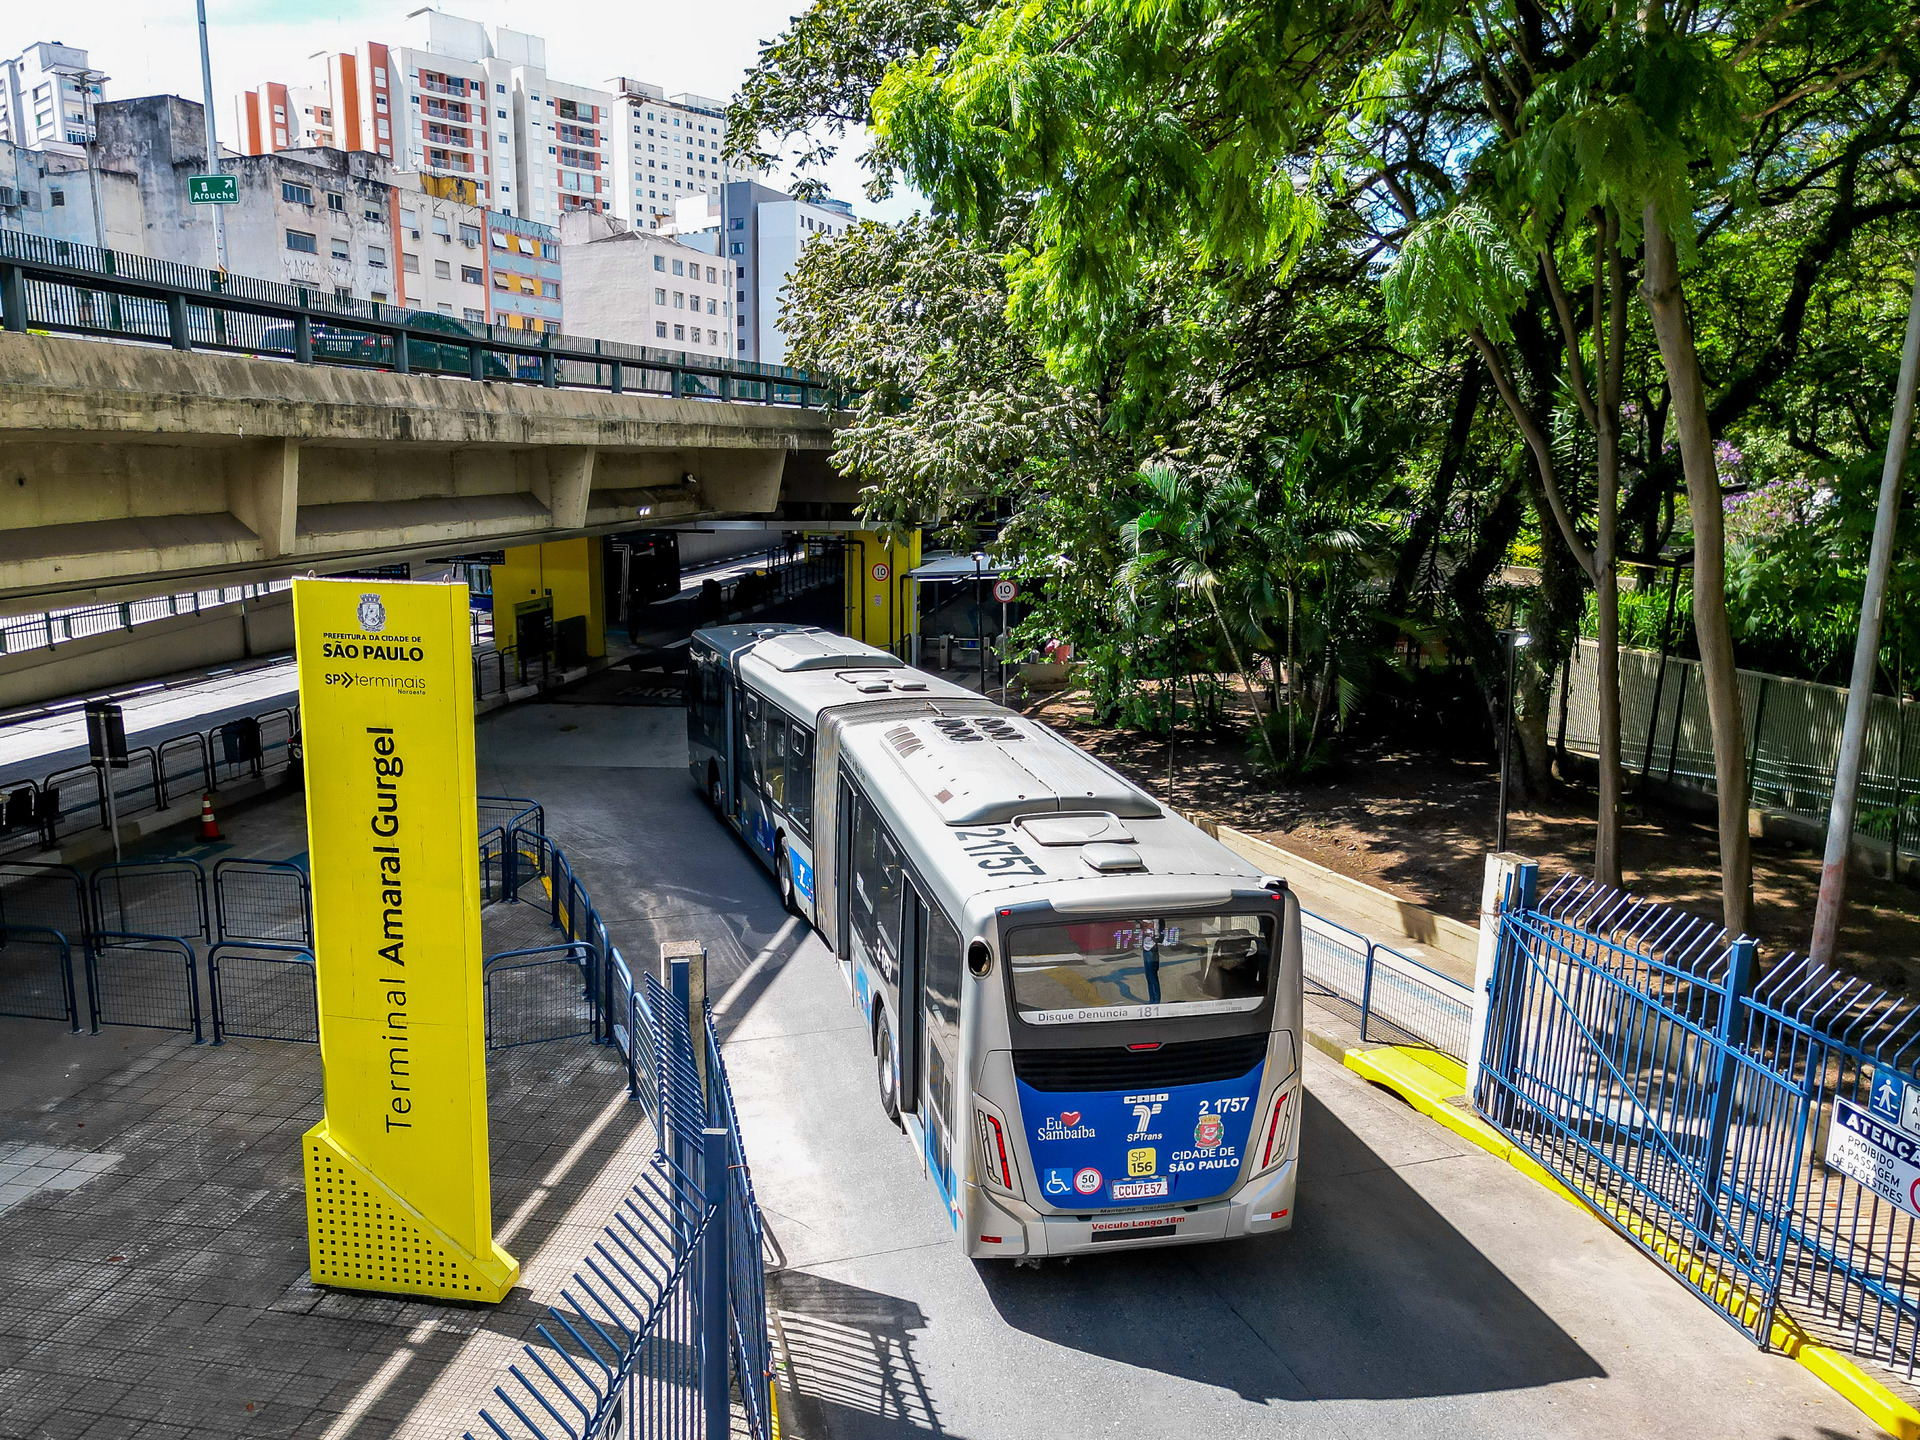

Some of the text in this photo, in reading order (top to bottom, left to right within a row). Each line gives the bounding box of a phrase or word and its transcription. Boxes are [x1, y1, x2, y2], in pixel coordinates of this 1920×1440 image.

[193, 190, 235, 200] Arouche
[876, 567, 886, 576] 10
[999, 585, 1011, 595] 10
[323, 632, 367, 641] PREFEITURA
[369, 634, 380, 642] DA
[381, 635, 409, 643] CIDADE
[323, 640, 424, 662] SÃO PAULO
[355, 672, 426, 689] terminais
[366, 727, 412, 1134] Terminal Amaral Gurgel
[1038, 1011, 1074, 1023] Disque
[1137, 1006, 1161, 1019] 181
[1123, 1093, 1169, 1105] CAIO
[1198, 1096, 1250, 1115] 2 1757
[1046, 1116, 1063, 1131] Eu
[1037, 1125, 1096, 1142] Sambaíba
[1126, 1132, 1163, 1142] SPTrans
[1131, 1151, 1147, 1162] SP
[1171, 1146, 1236, 1161] CIDADE DE
[1848, 1135, 1894, 1169] PROIBIDO
[1131, 1161, 1153, 1174] 156
[1168, 1157, 1240, 1173] SÃO PAULO
[1838, 1144, 1900, 1188] A PASSAGEM
[1081, 1174, 1095, 1184] 50
[1832, 1153, 1903, 1204] DE PEDESTRES
[1118, 1183, 1162, 1197] CCU7E57
[1091, 1216, 1185, 1230] Veículo Longo 18m
